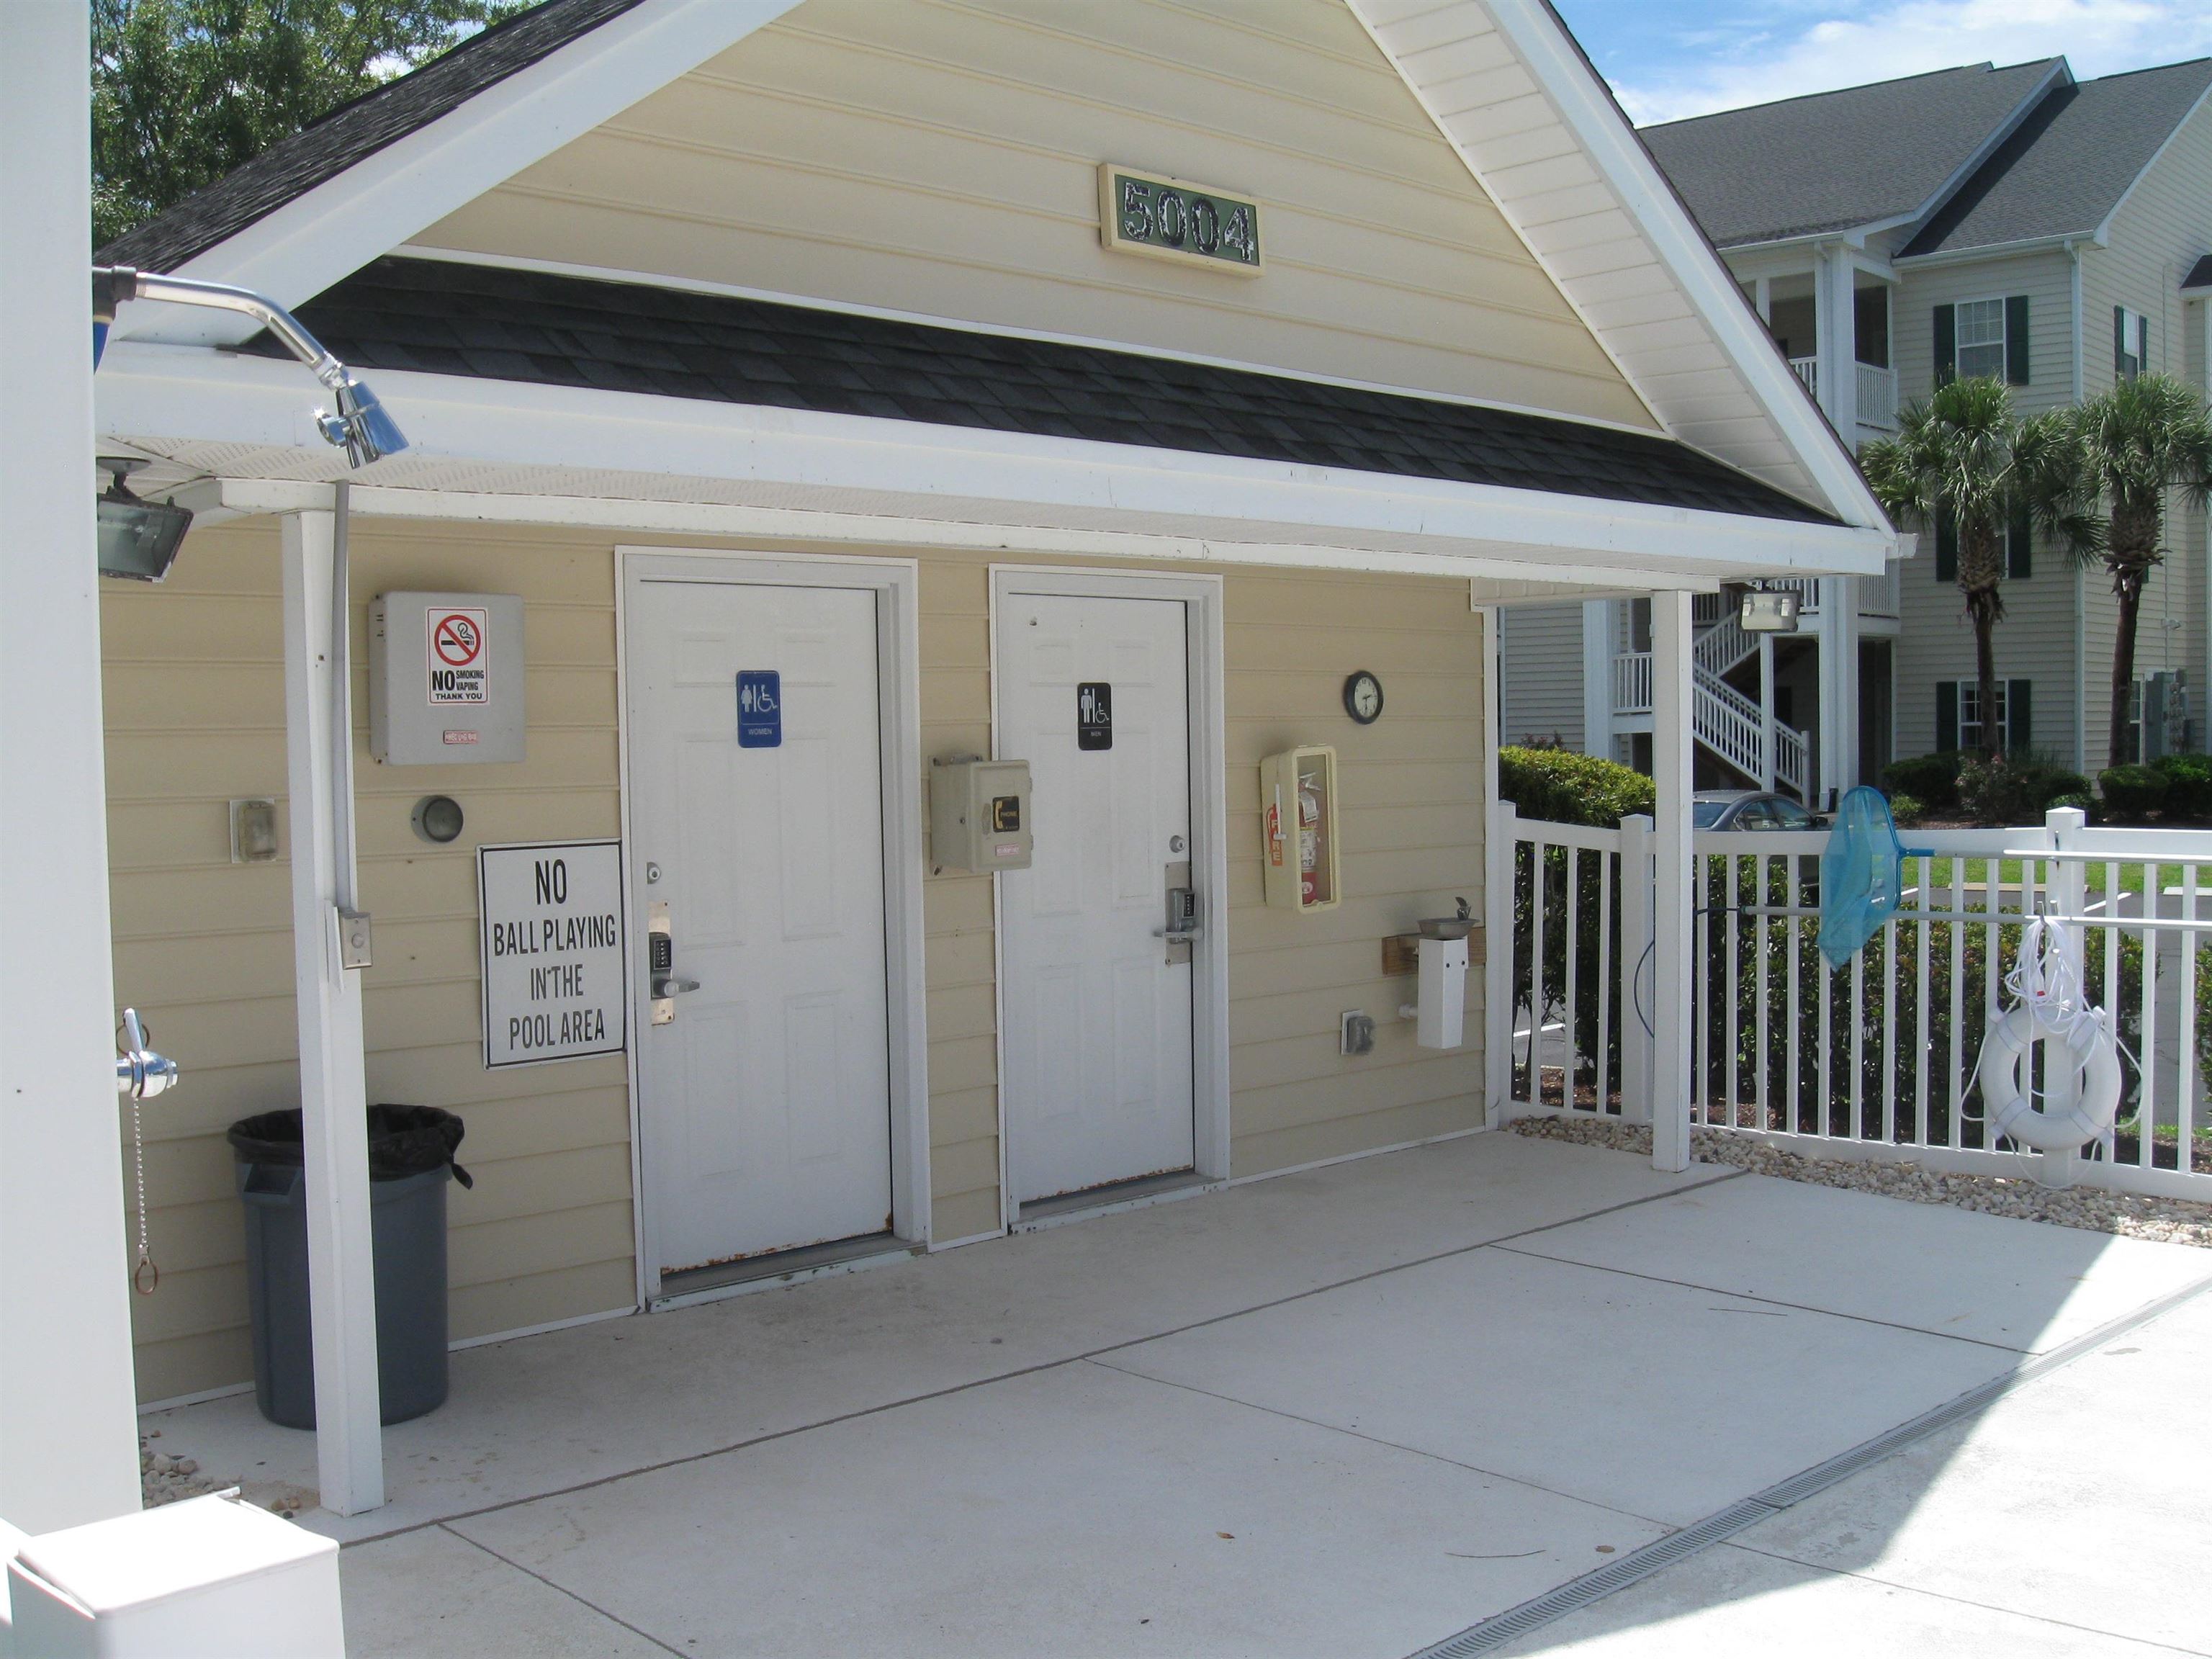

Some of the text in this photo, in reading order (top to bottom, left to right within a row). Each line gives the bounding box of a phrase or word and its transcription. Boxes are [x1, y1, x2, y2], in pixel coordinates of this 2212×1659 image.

[1123, 181, 1255, 261] 5004
[432, 670, 485, 691] NO SMOKING
[457, 681, 479, 691] VAPING
[1272, 819, 1282, 860] FRE
[535, 859, 567, 905] NO
[493, 914, 616, 956] BALL PLAYING
[530, 964, 584, 1000] IN THE
[509, 1008, 606, 1051] POOL AREA
